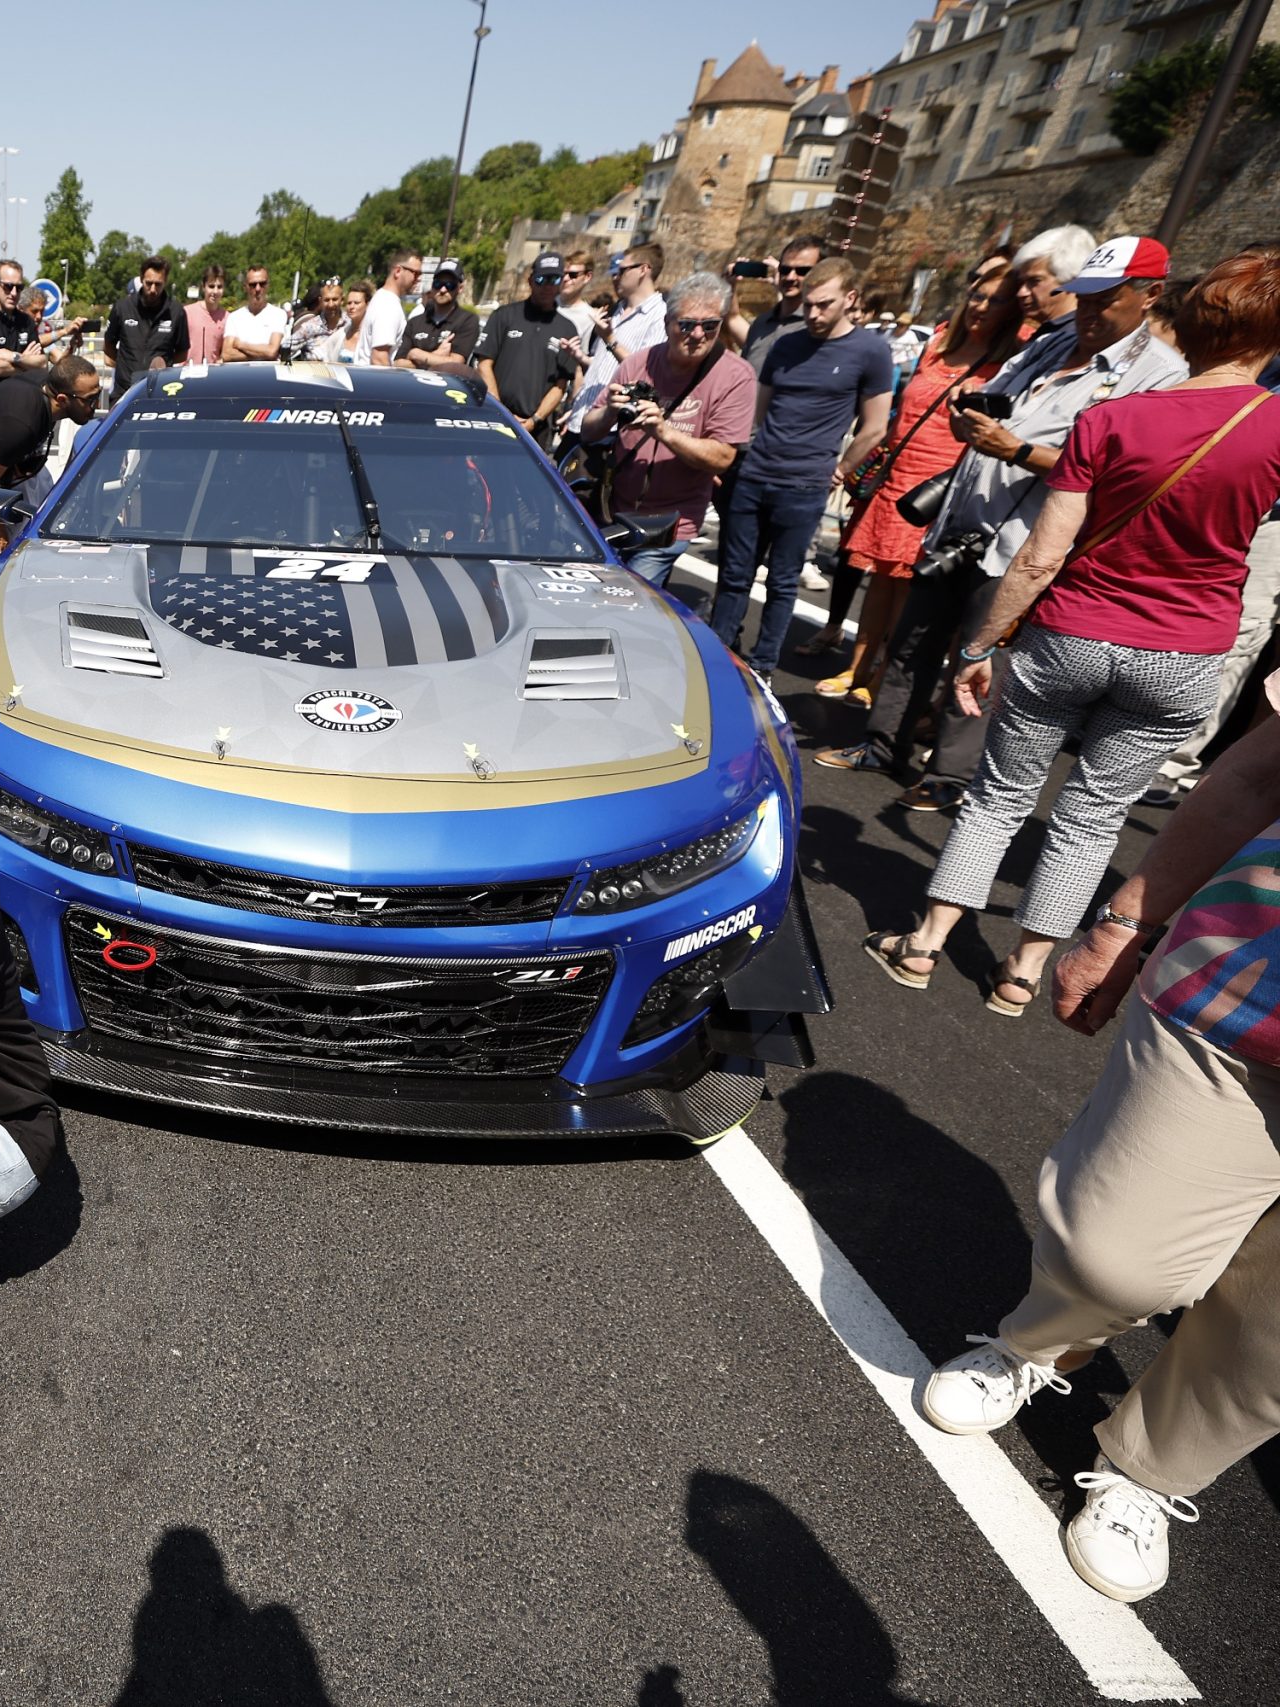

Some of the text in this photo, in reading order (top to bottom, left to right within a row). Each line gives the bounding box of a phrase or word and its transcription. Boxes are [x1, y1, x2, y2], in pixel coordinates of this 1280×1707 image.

[131, 411, 197, 421] 1948
[276, 409, 385, 427] NASCAR
[265, 558, 376, 583] 24
[308, 690, 387, 707] NASCAR 75TH
[307, 713, 391, 732] ANNIVERSARY
[686, 904, 757, 953] NASCAR
[506, 965, 585, 984] ZL1
